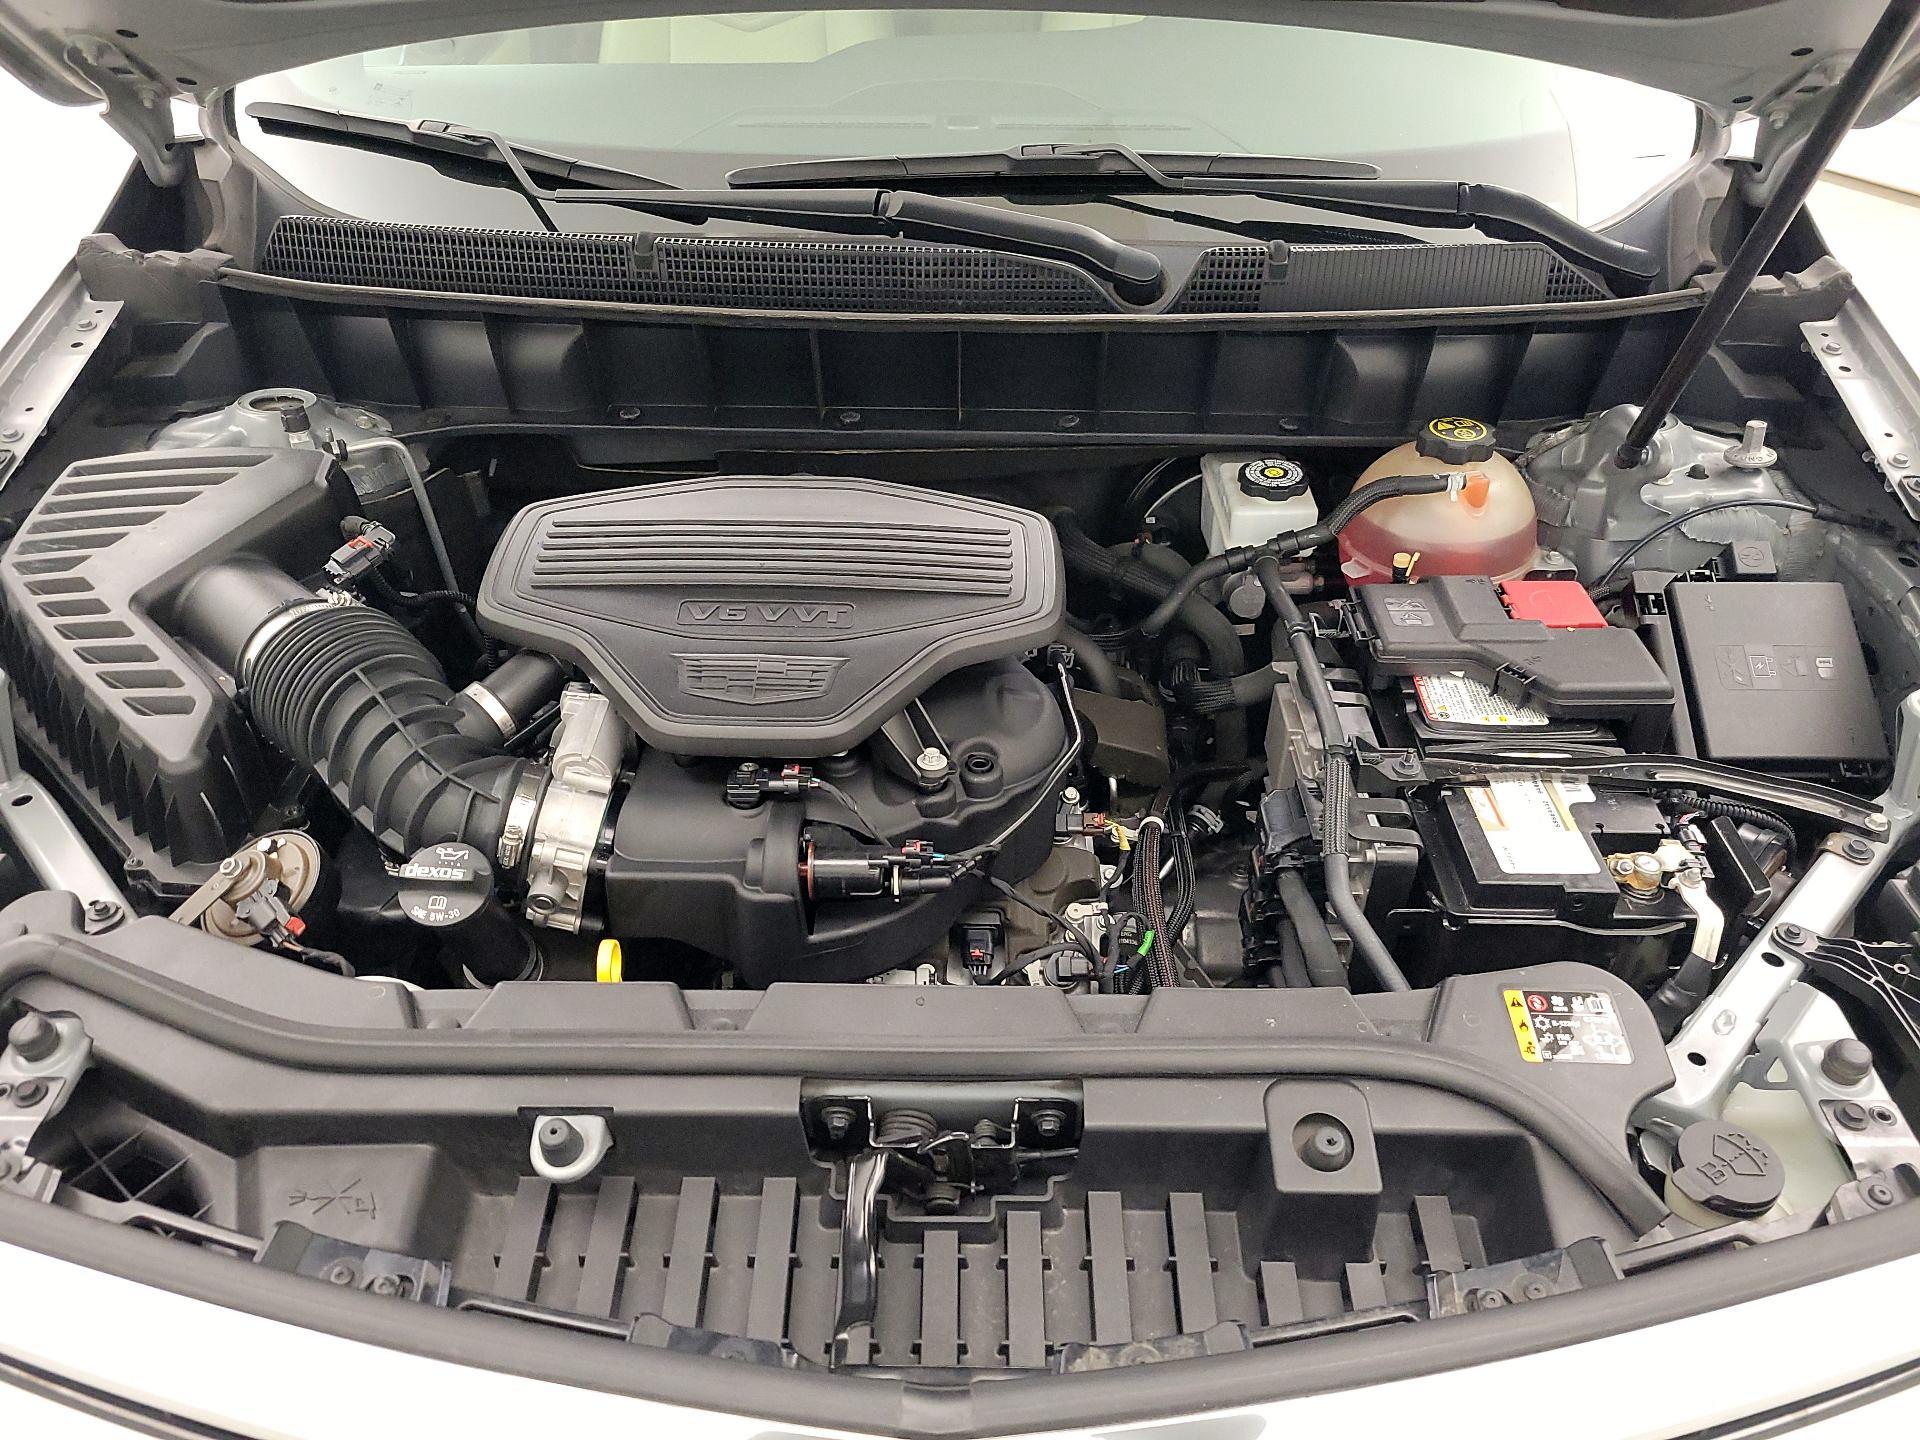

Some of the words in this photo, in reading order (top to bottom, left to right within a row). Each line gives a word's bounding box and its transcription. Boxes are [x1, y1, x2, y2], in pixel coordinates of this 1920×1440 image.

[686, 604, 748, 622] V6
[756, 604, 849, 624] VVT
[404, 862, 464, 880] dexos
[410, 905, 428, 920] SAE
[429, 908, 461, 922] 5W-30
